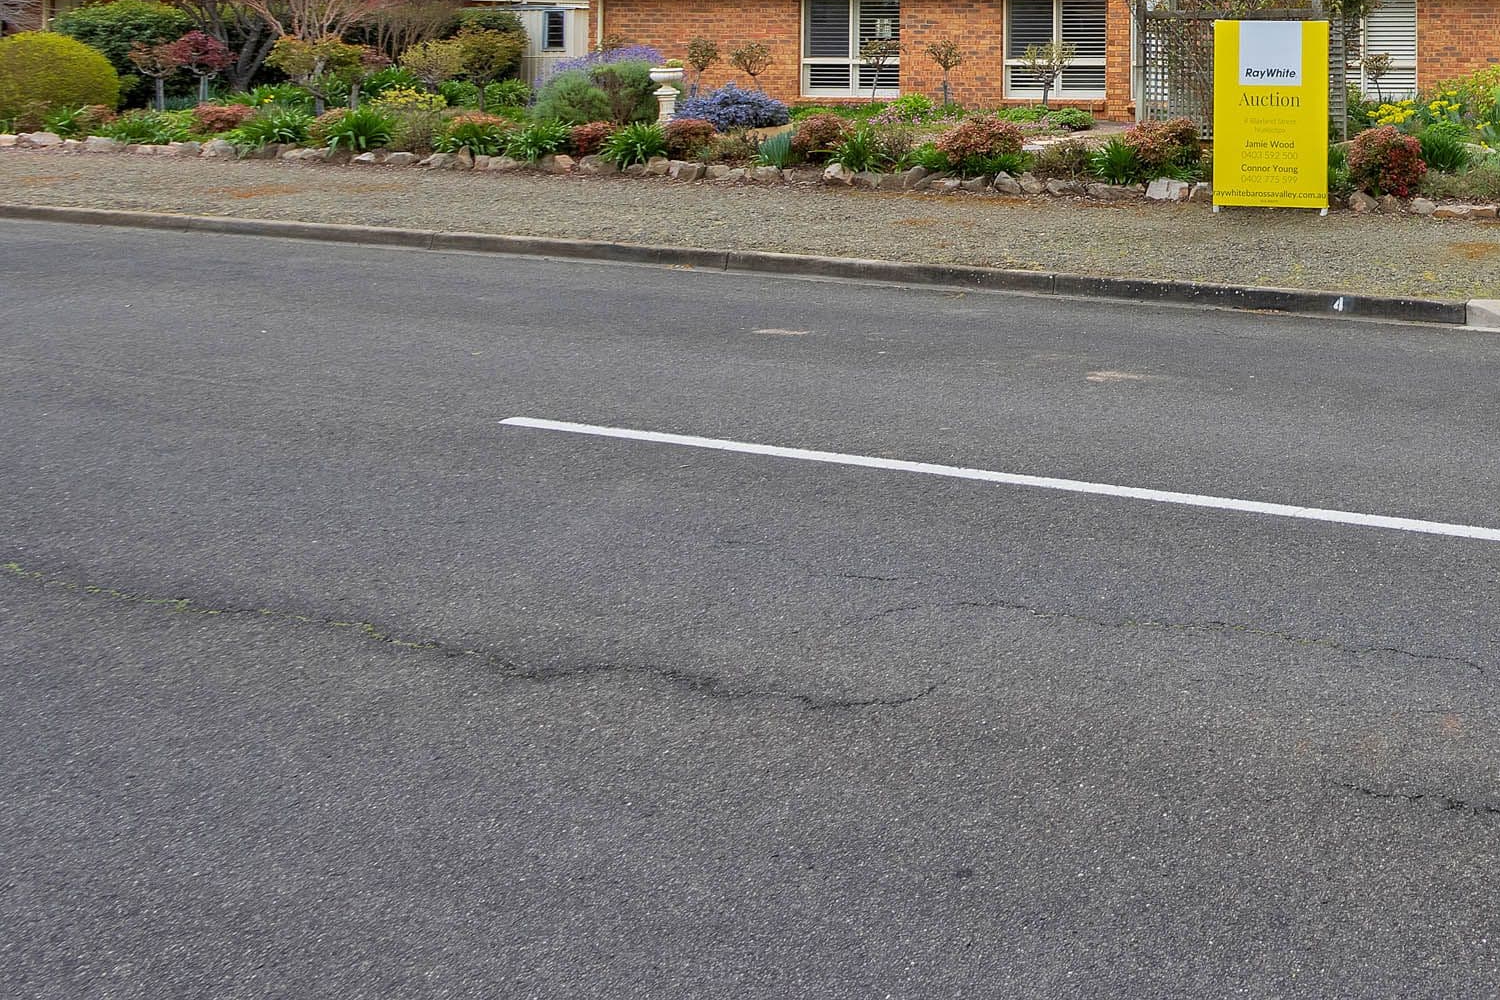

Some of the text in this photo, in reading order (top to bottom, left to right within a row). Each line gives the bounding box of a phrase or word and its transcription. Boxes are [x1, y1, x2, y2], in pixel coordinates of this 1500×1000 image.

[1245, 68, 1296, 79] RayWhite
[1239, 92, 1301, 108] Auction
[1245, 139, 1295, 149] Jamie Wood
[1241, 150, 1298, 160] 0403 592 500
[1241, 163, 1299, 175] Connor Young
[1241, 174, 1262, 184] 0402
[1213, 188, 1327, 200] raywhitebarossavalley.com.au
[1333, 296, 1344, 312] 4
